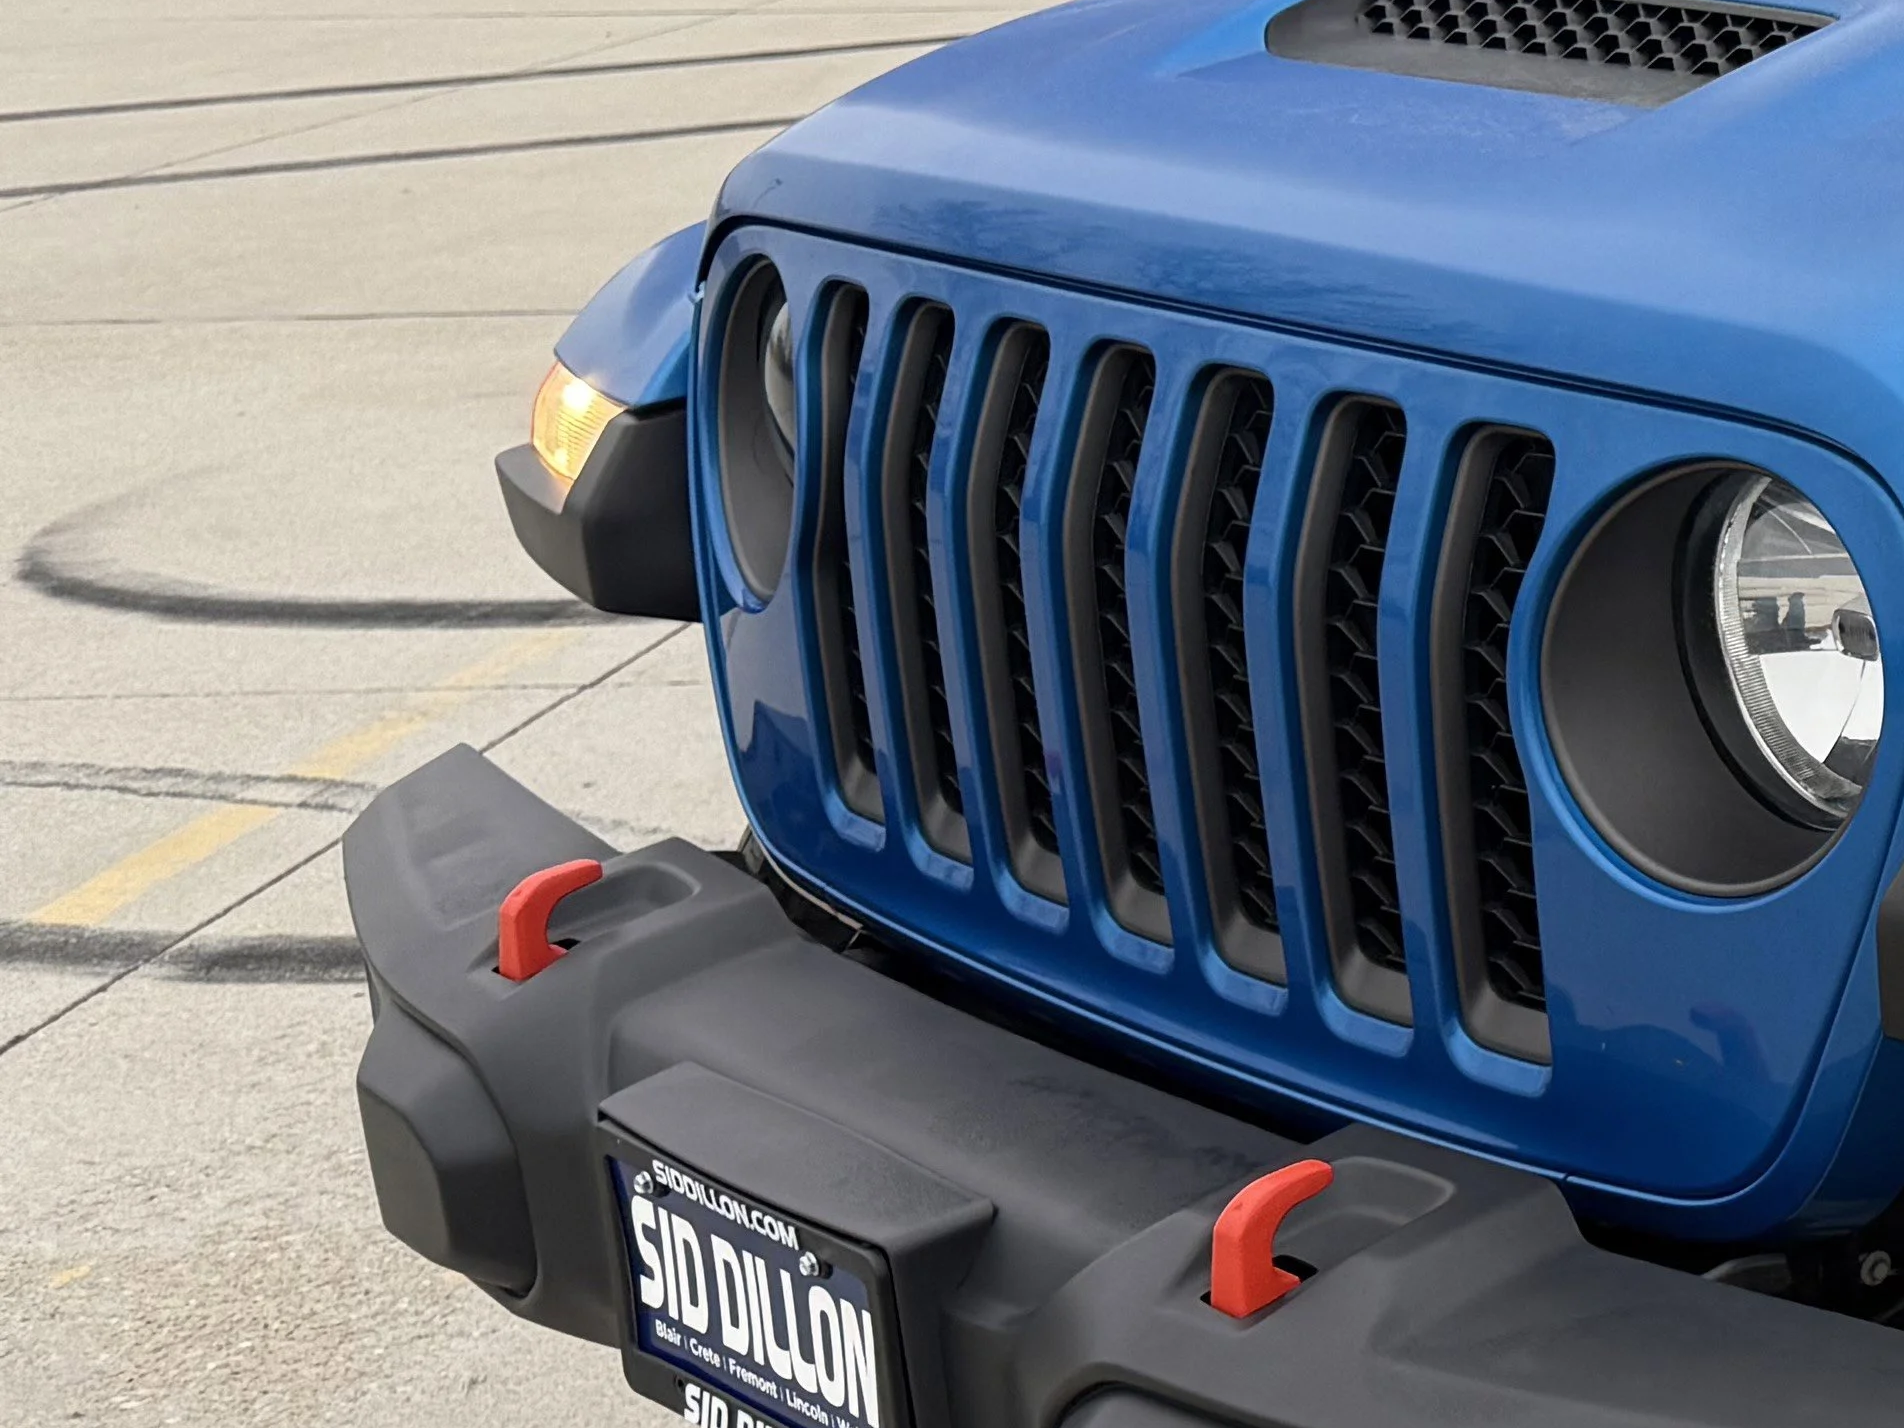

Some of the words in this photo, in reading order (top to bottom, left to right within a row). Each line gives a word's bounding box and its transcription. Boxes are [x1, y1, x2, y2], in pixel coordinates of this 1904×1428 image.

[651, 1158, 799, 1251] SIDDILLON.COM
[631, 1195, 710, 1335] SID
[655, 1319, 682, 1348] Blair
[690, 1337, 722, 1368] Crete
[729, 1358, 778, 1400] Fremont
[785, 1388, 829, 1427] Lincoln
